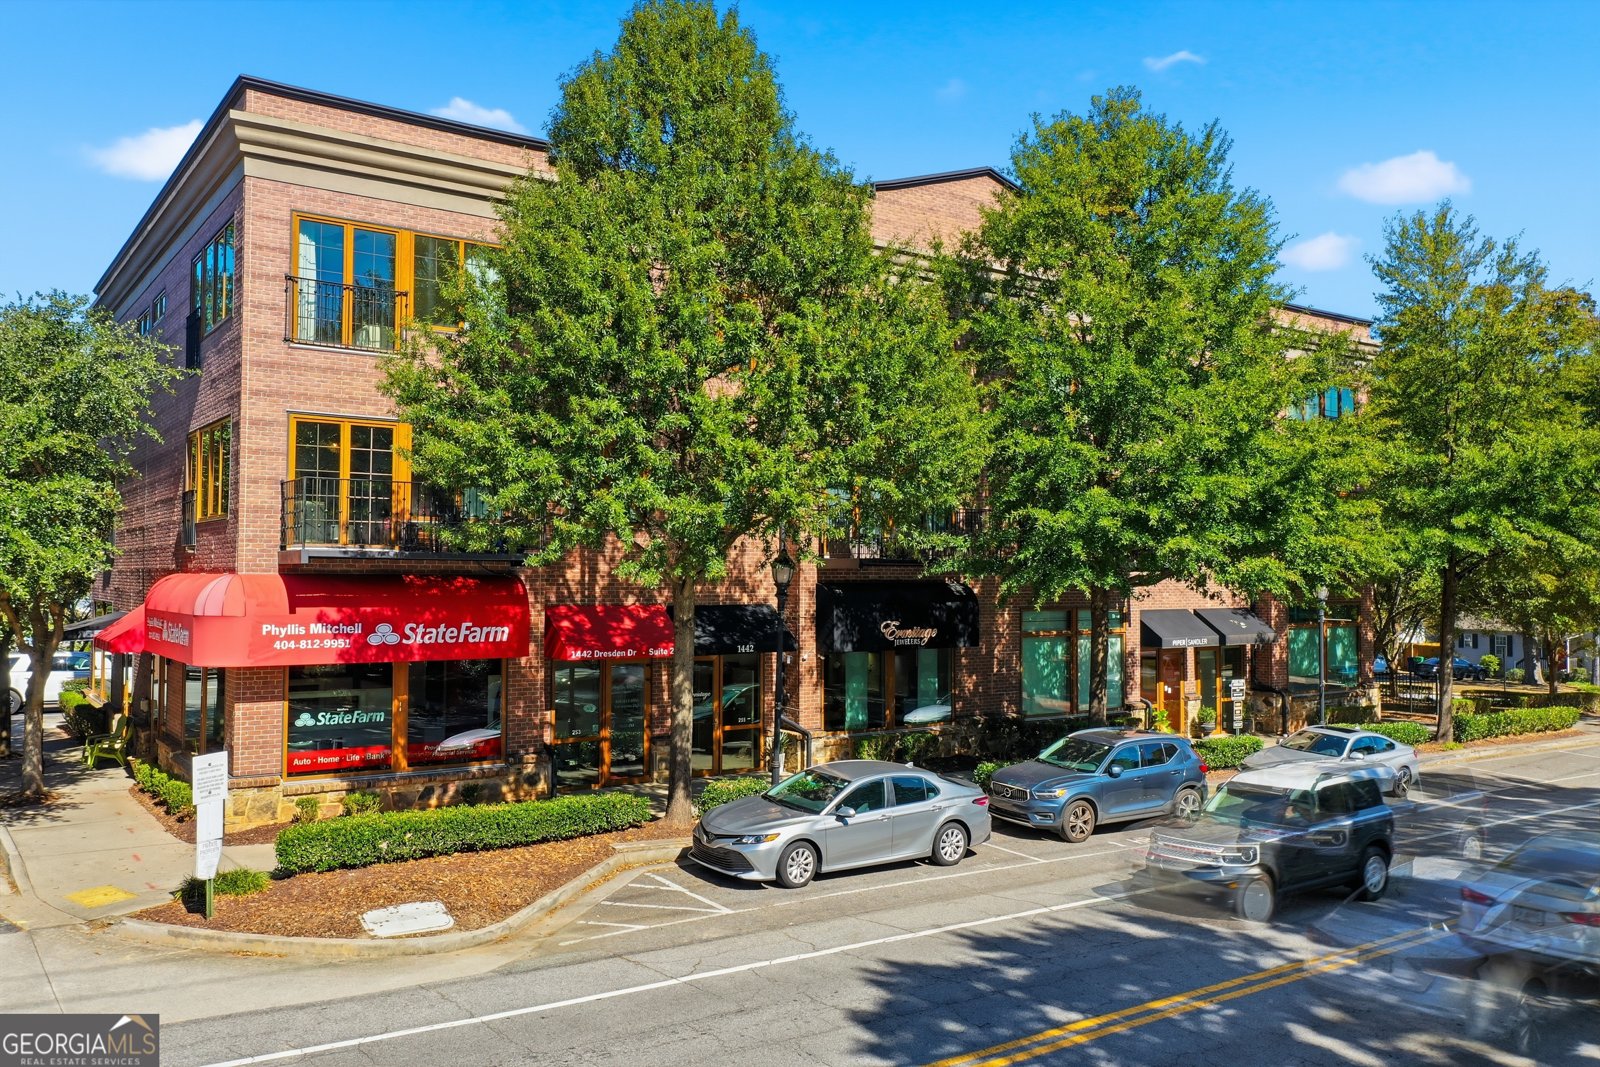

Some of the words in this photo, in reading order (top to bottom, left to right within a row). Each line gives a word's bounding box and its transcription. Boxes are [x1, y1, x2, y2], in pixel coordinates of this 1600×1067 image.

[262, 623, 305, 638] Phyllis
[310, 623, 362, 634] Mitchell
[273, 639, 351, 650] 404-812-9951
[737, 644, 754, 653] 1442
[571, 650, 592, 659] 1442
[594, 649, 626, 658] Dresden
[627, 649, 637, 657] Dr
[649, 648, 668, 656] Suite
[293, 758, 311, 766] Auto
[317, 756, 340, 764] Home
[346, 754, 360, 762] Life
